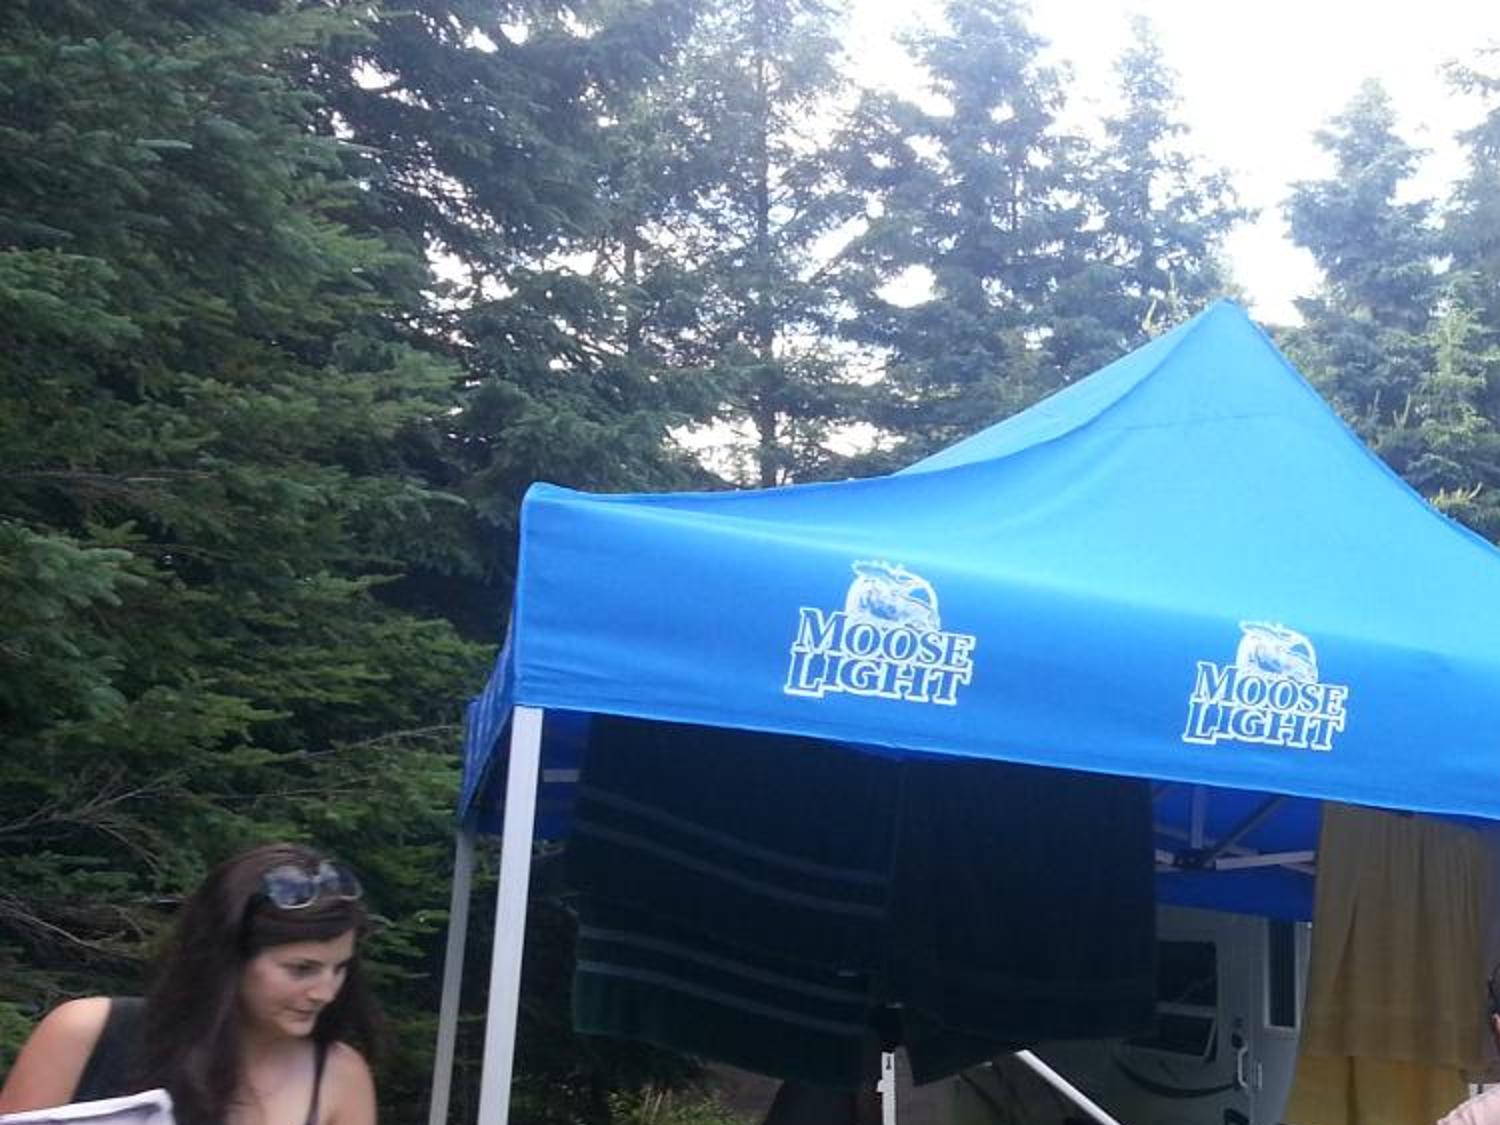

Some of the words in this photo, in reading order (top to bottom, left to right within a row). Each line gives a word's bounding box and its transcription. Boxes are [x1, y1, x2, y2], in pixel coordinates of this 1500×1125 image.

[797, 606, 975, 669] MOOSE
[784, 649, 971, 705] LIGHT
[1194, 662, 1347, 717] MOOSE
[1183, 701, 1342, 750] LIGHT
